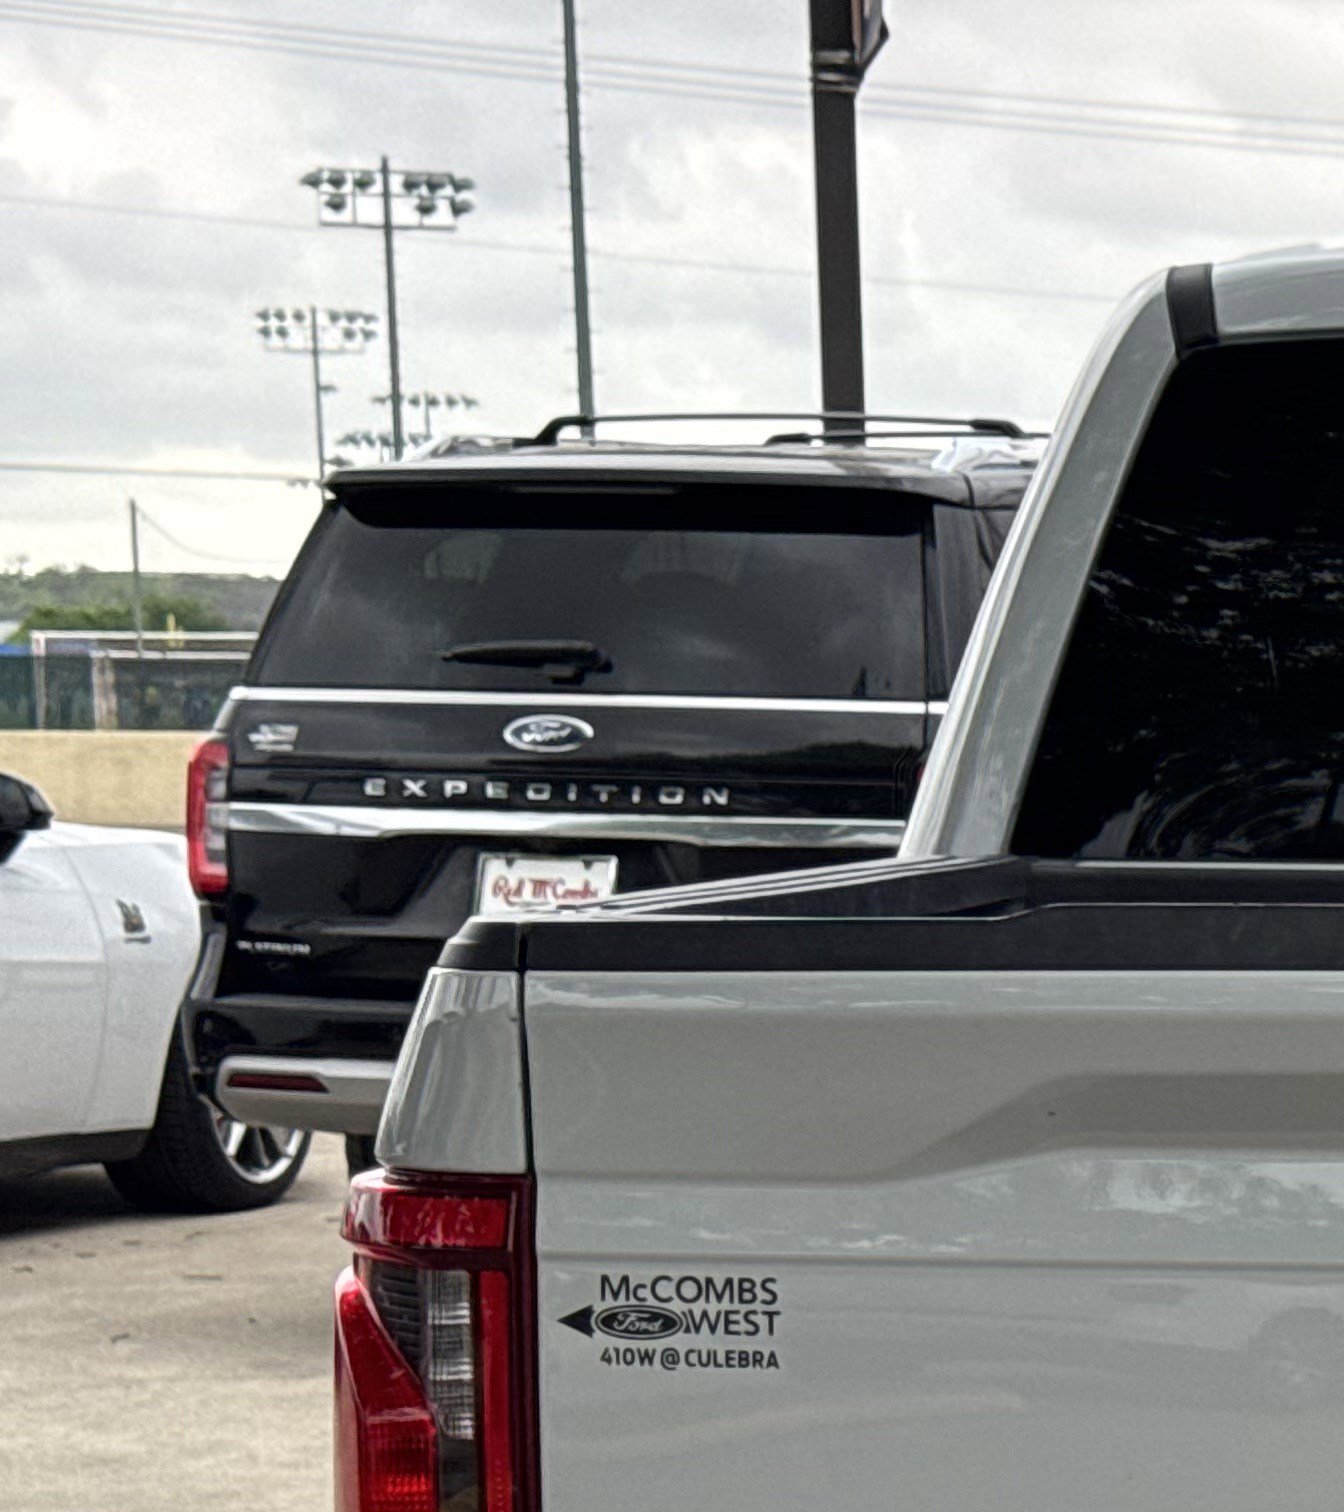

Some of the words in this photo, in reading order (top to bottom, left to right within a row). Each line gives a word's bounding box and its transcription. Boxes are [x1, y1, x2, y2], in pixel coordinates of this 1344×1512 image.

[362, 776, 731, 806] EXPEDITION
[599, 1273, 779, 1306] McCOMBS
[686, 1308, 782, 1337] WEST
